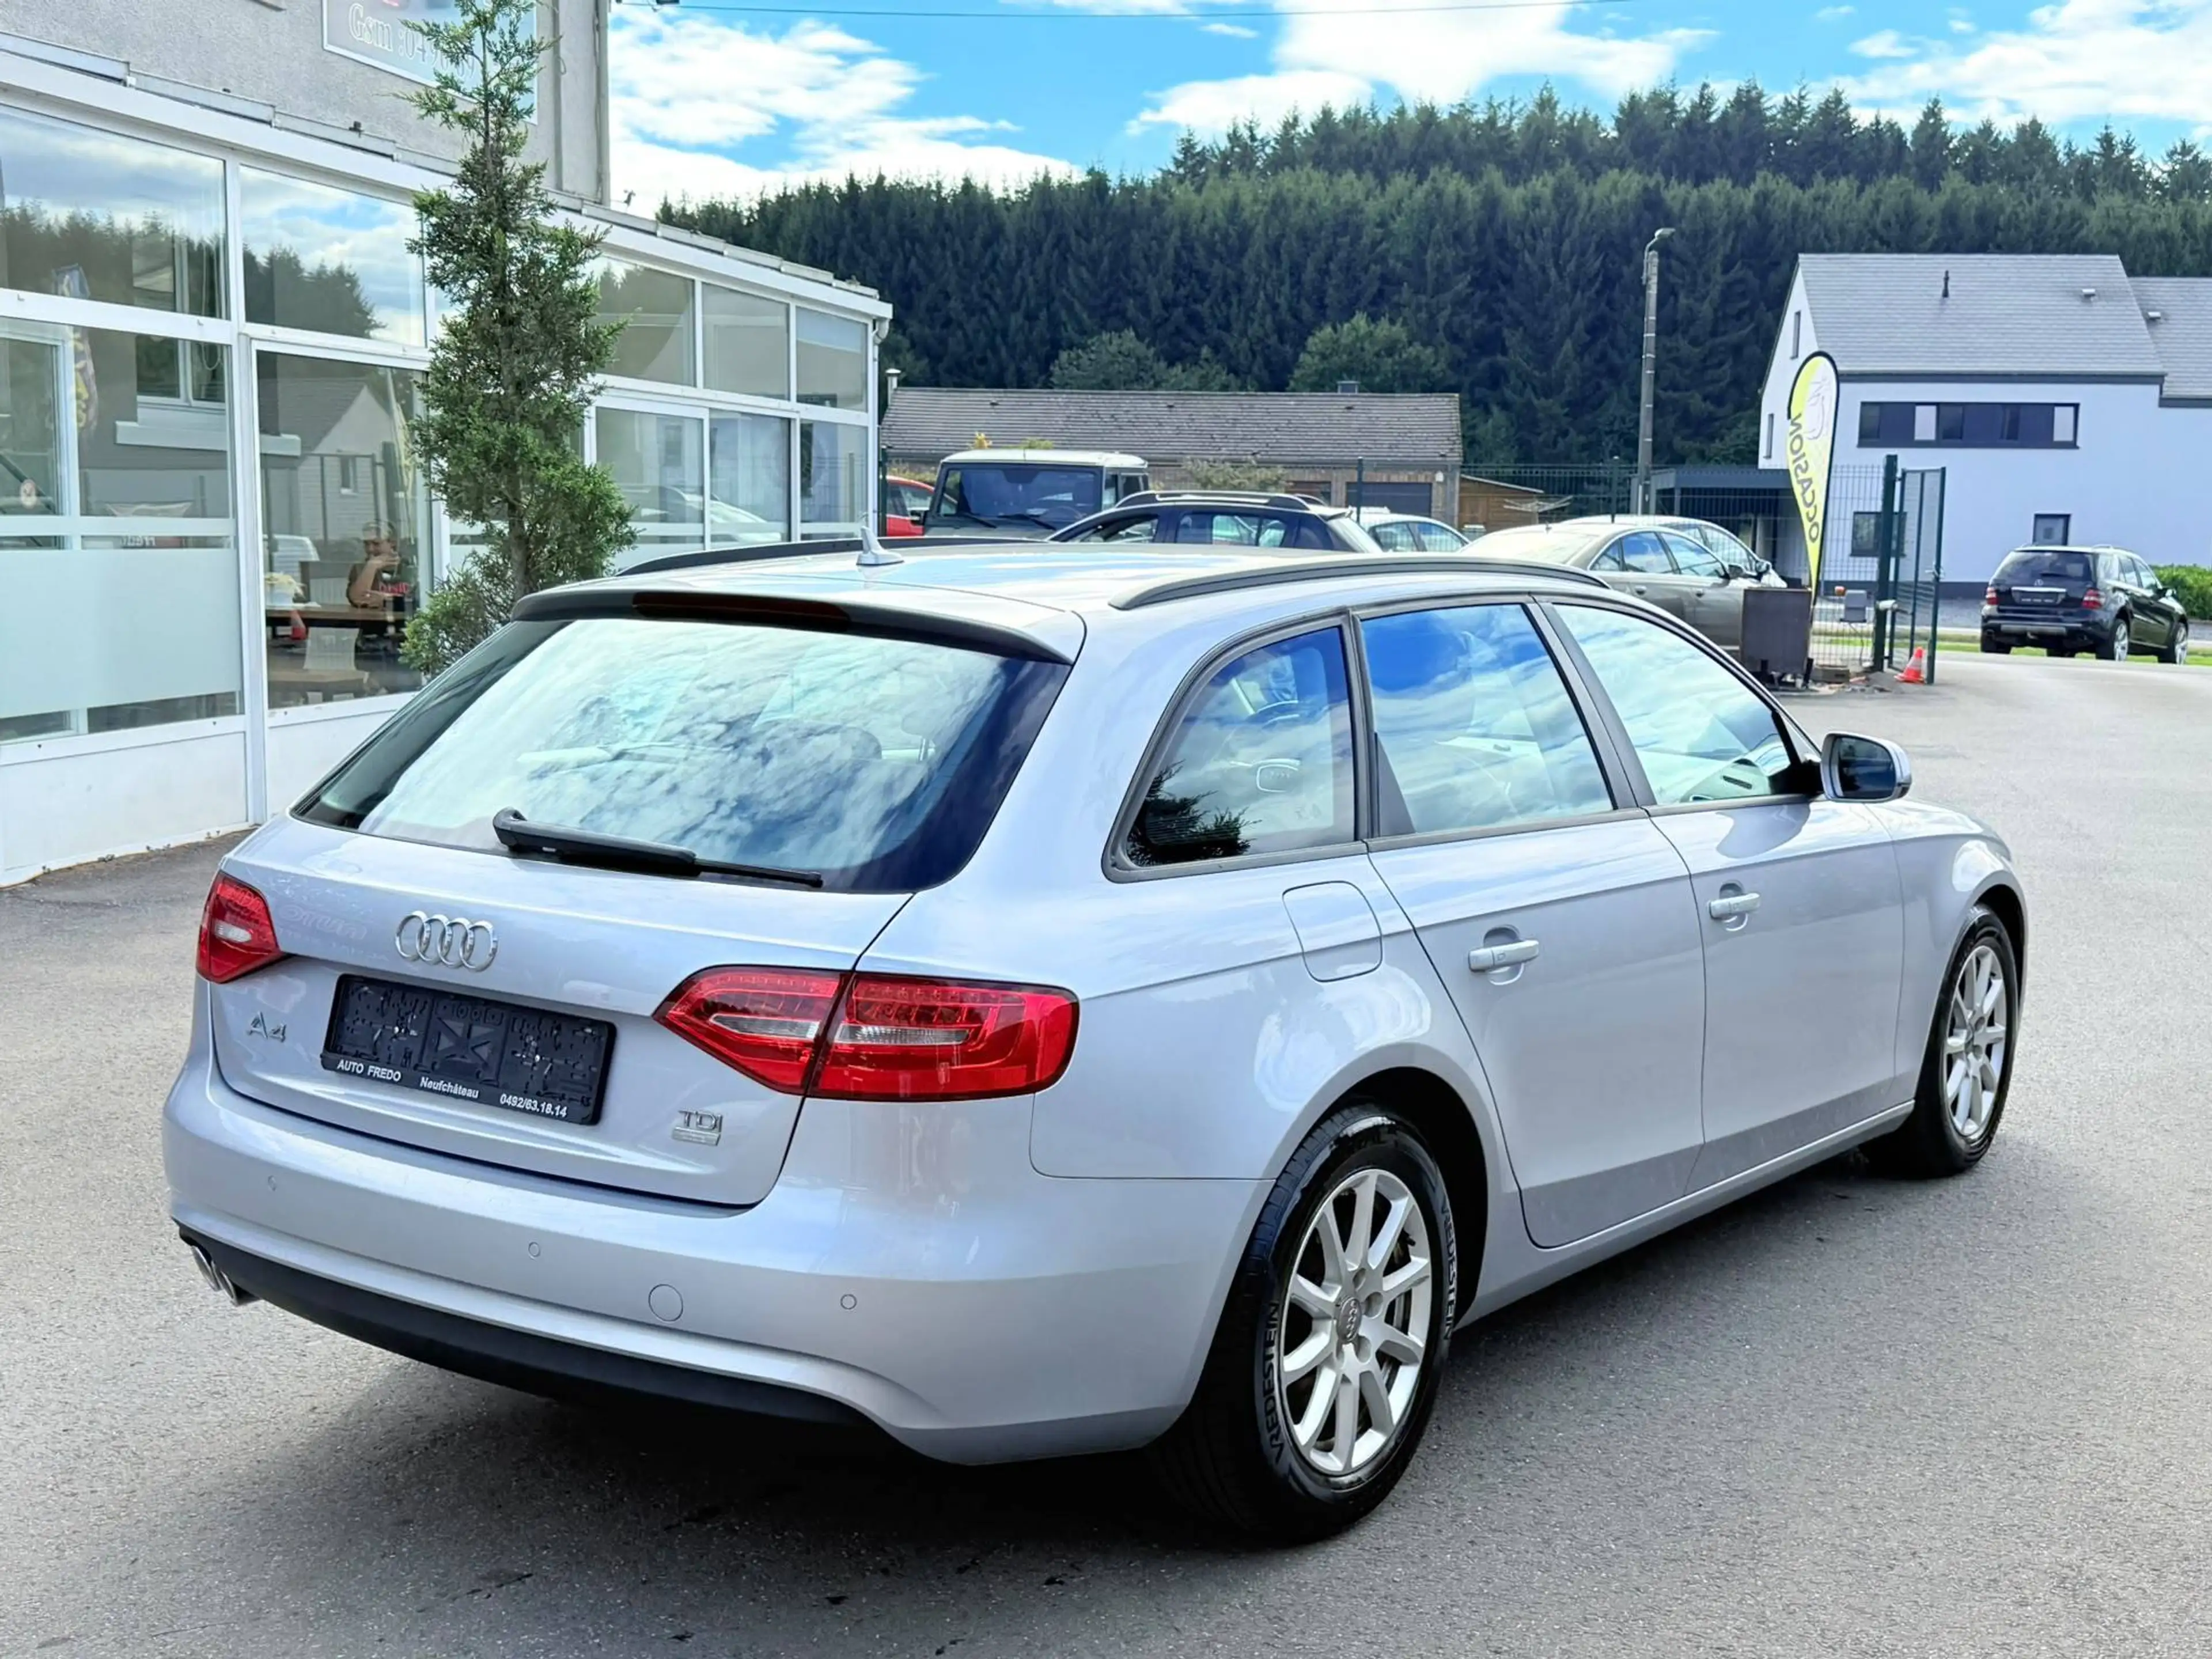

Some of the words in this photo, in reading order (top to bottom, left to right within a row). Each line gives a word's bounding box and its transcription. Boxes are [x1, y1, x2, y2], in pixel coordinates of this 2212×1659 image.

[349, 2, 393, 52] Gsm
[246, 1011, 287, 1043] A4
[336, 1059, 363, 1074] AUTO
[367, 1065, 402, 1082] FREDO
[419, 1076, 479, 1099] Neufchâteau
[499, 1093, 567, 1118] 0492/63.18.14
[677, 1109, 723, 1133] TDI
[1441, 1195, 1456, 1340] VREDESTEIN
[1262, 1301, 1285, 1465] VREDESTEIN
